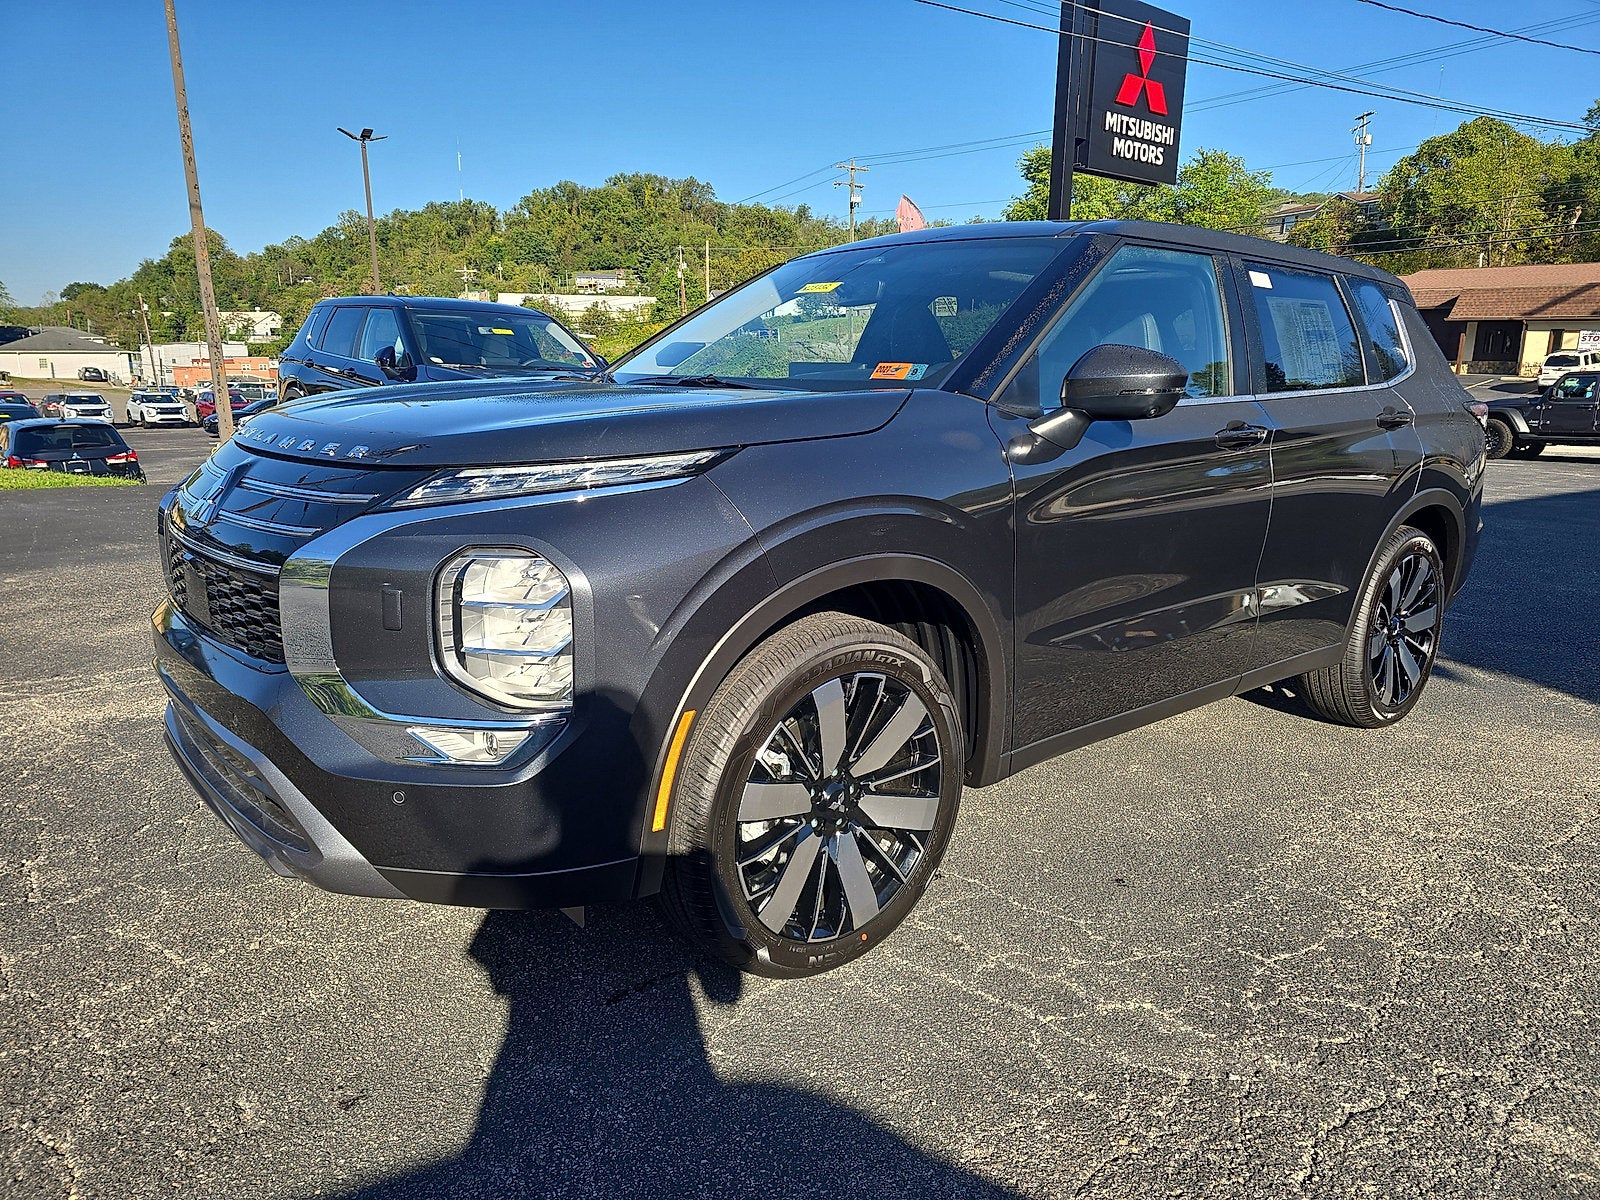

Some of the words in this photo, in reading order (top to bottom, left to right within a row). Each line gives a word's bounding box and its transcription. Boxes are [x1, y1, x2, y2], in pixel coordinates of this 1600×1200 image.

[1106, 111, 1175, 146] MITSUBISHI
[1113, 137, 1164, 165] MOTORS
[875, 653, 906, 668] GTX
